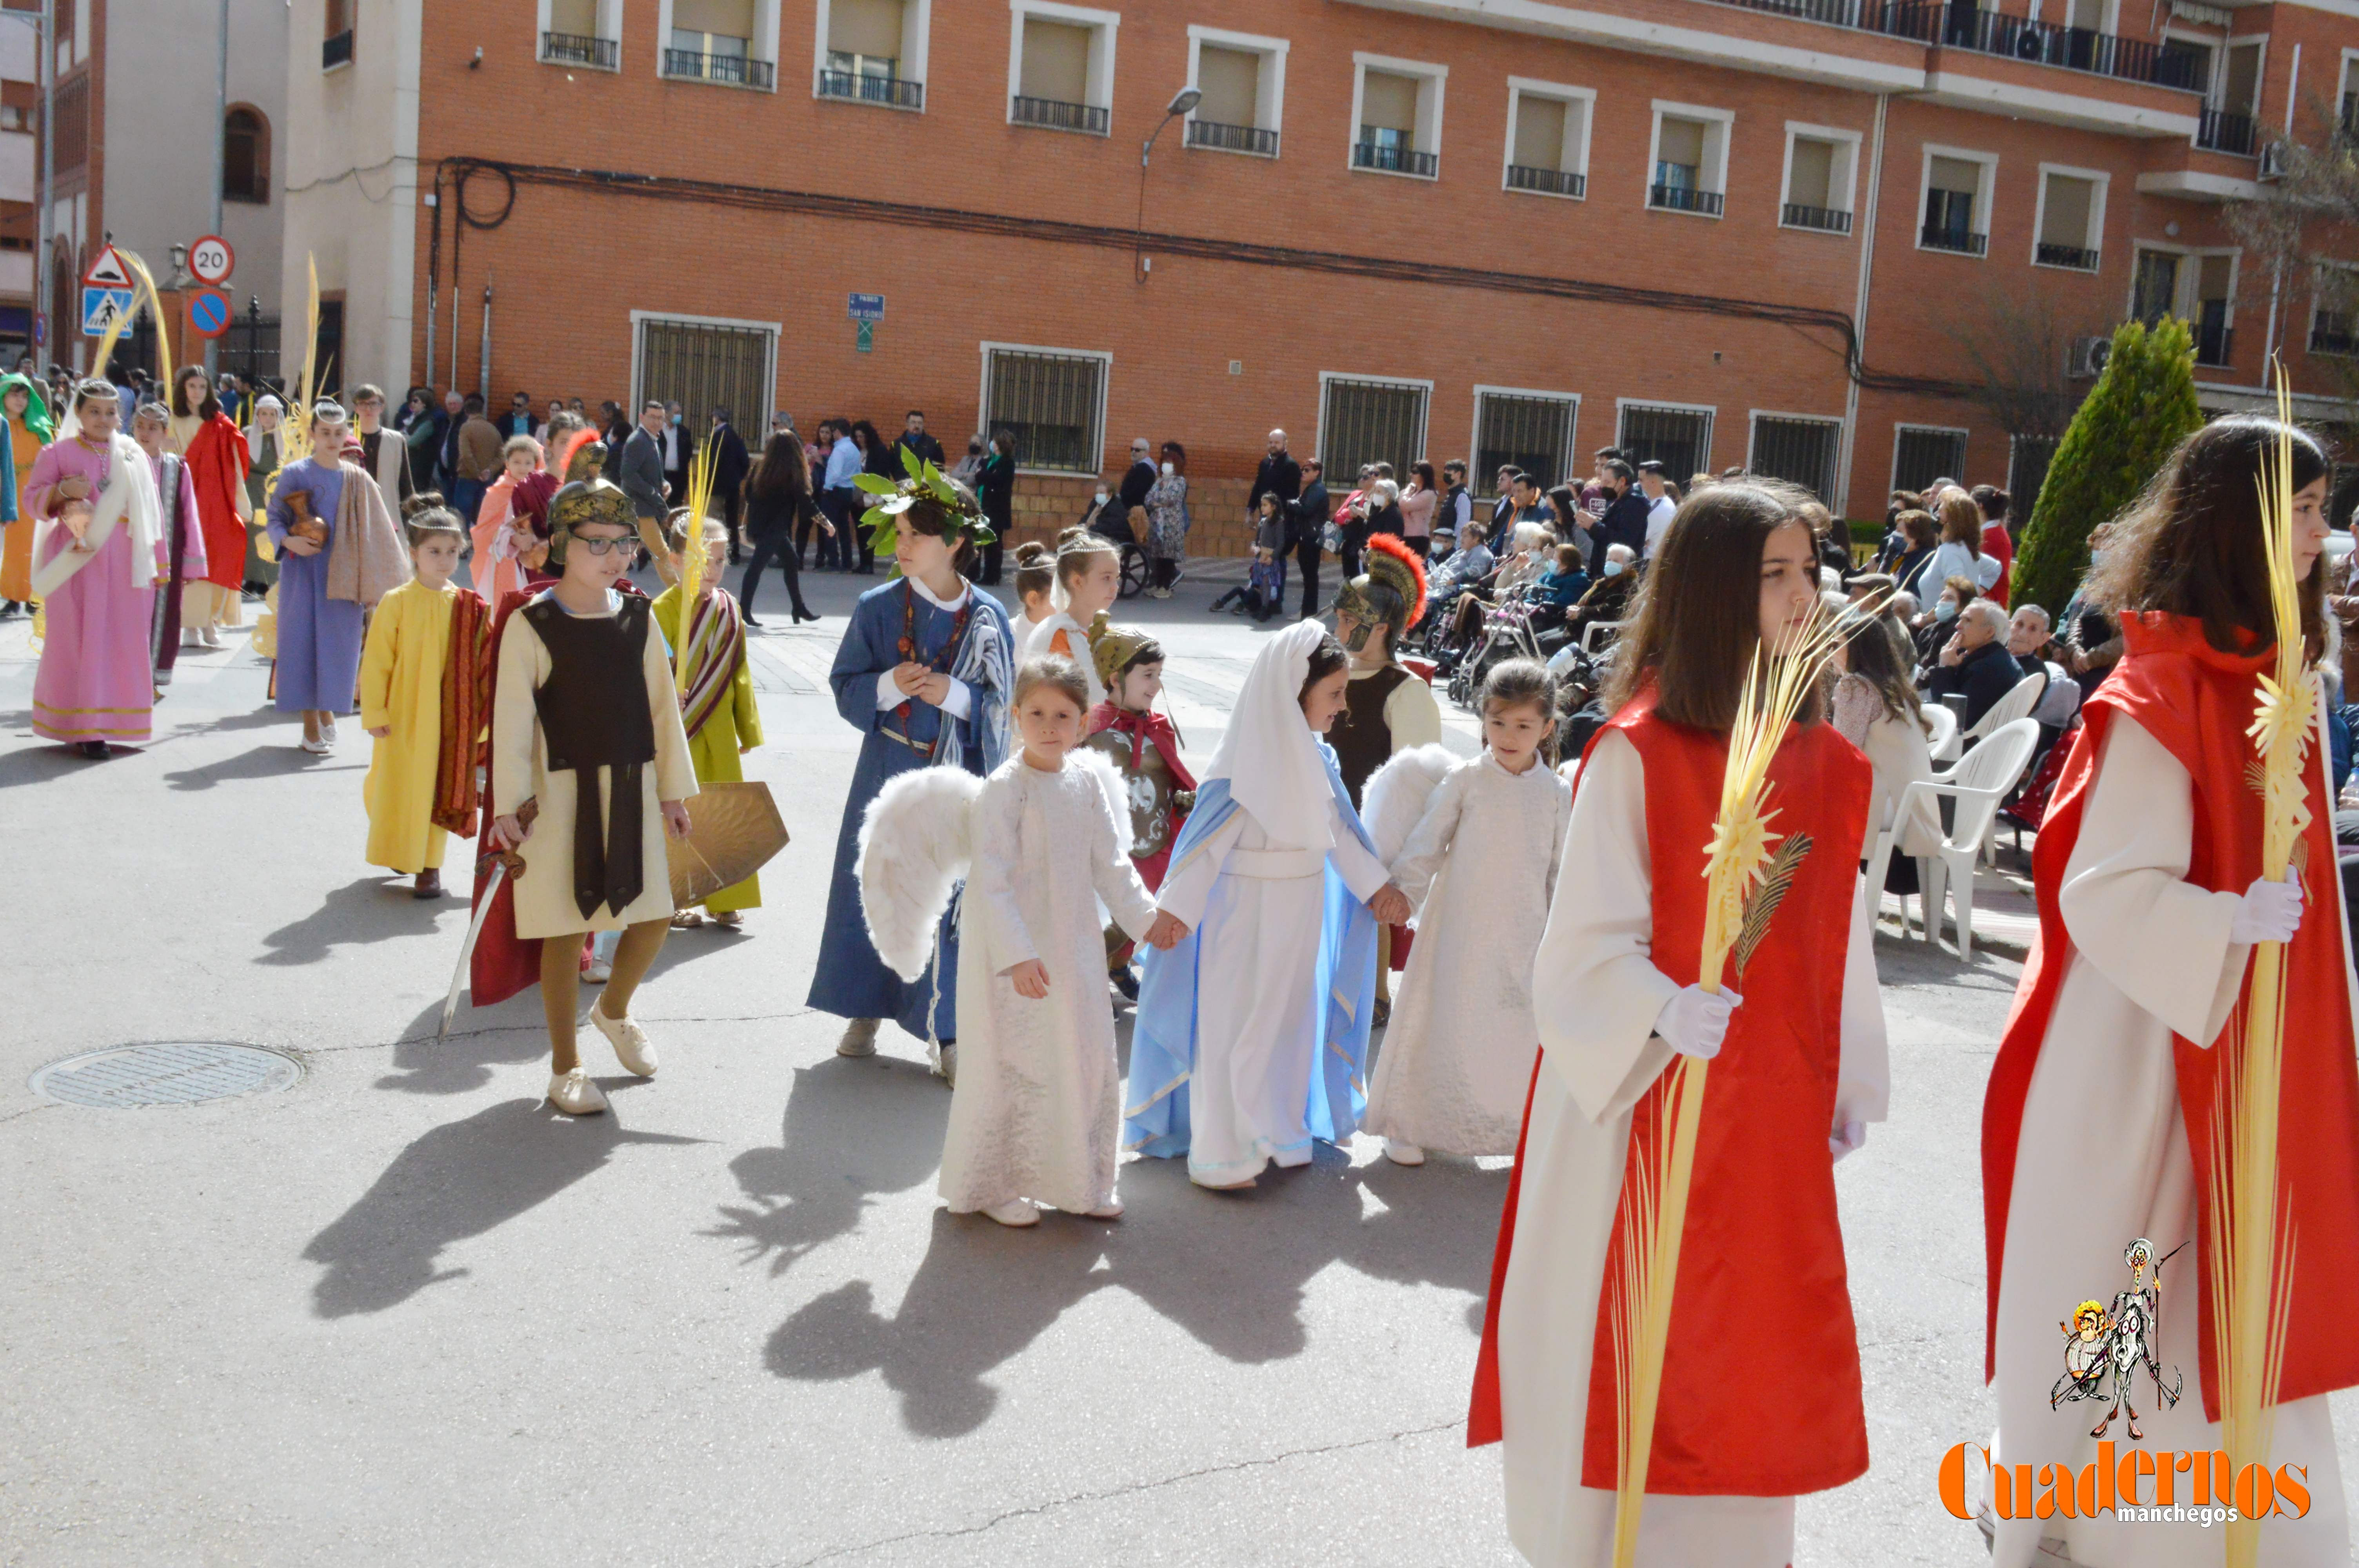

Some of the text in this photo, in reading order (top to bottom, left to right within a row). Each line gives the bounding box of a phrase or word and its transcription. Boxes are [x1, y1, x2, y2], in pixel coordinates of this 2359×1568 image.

[199, 252, 223, 268] 20
[850, 309, 882, 319] SAN ISIDRO
